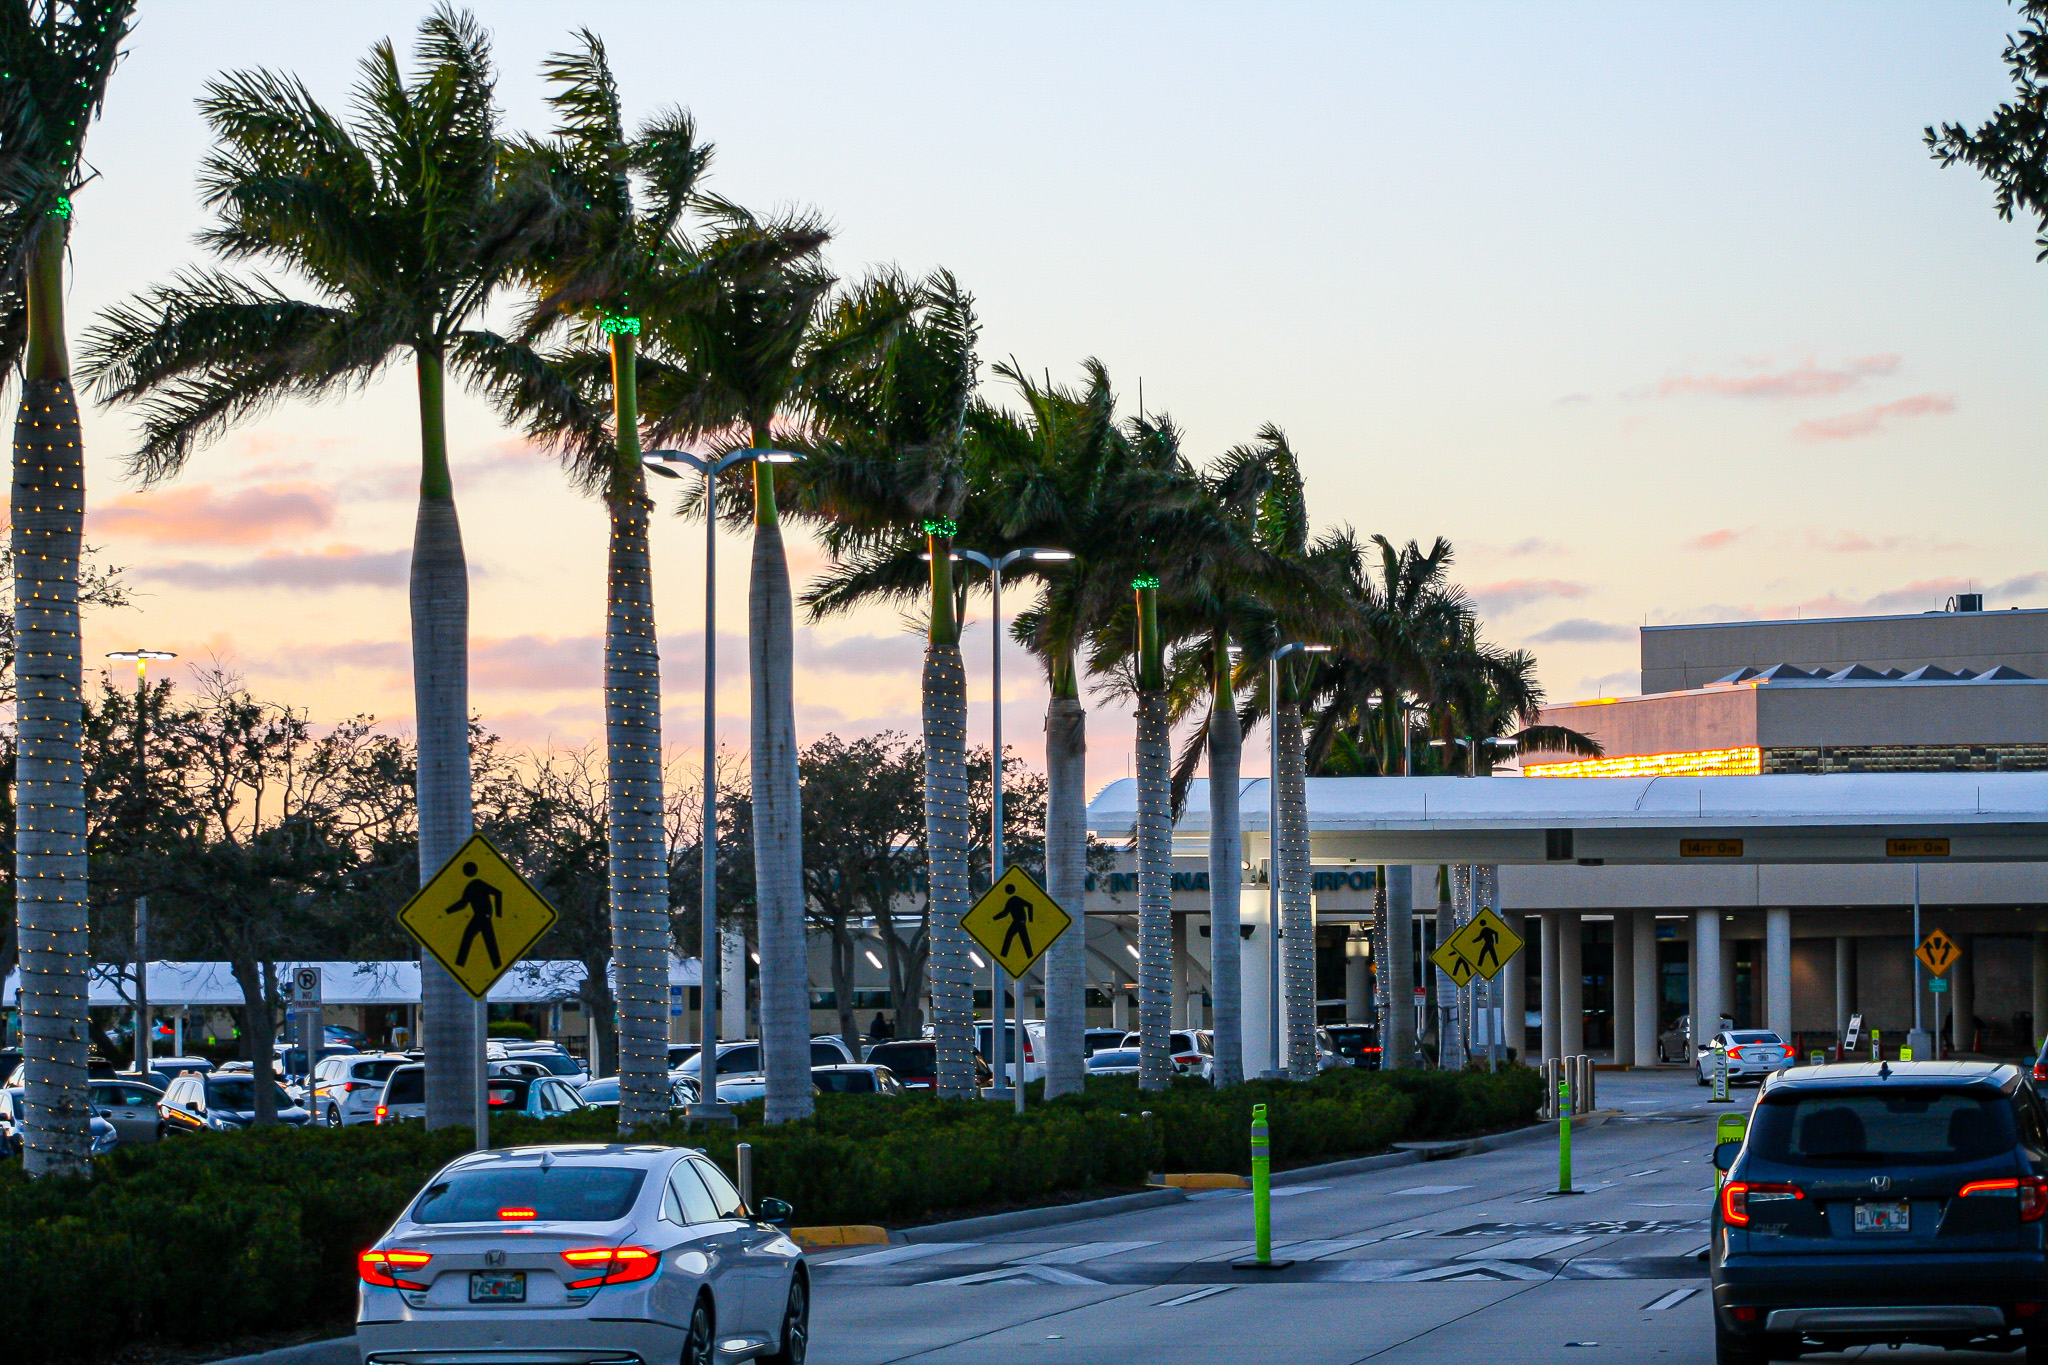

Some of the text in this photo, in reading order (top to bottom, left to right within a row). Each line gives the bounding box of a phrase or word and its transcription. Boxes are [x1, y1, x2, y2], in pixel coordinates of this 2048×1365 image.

[1311, 871, 1377, 891] IRPOR
[302, 991, 313, 999] NO
[295, 1000, 320, 1009] PARKING
